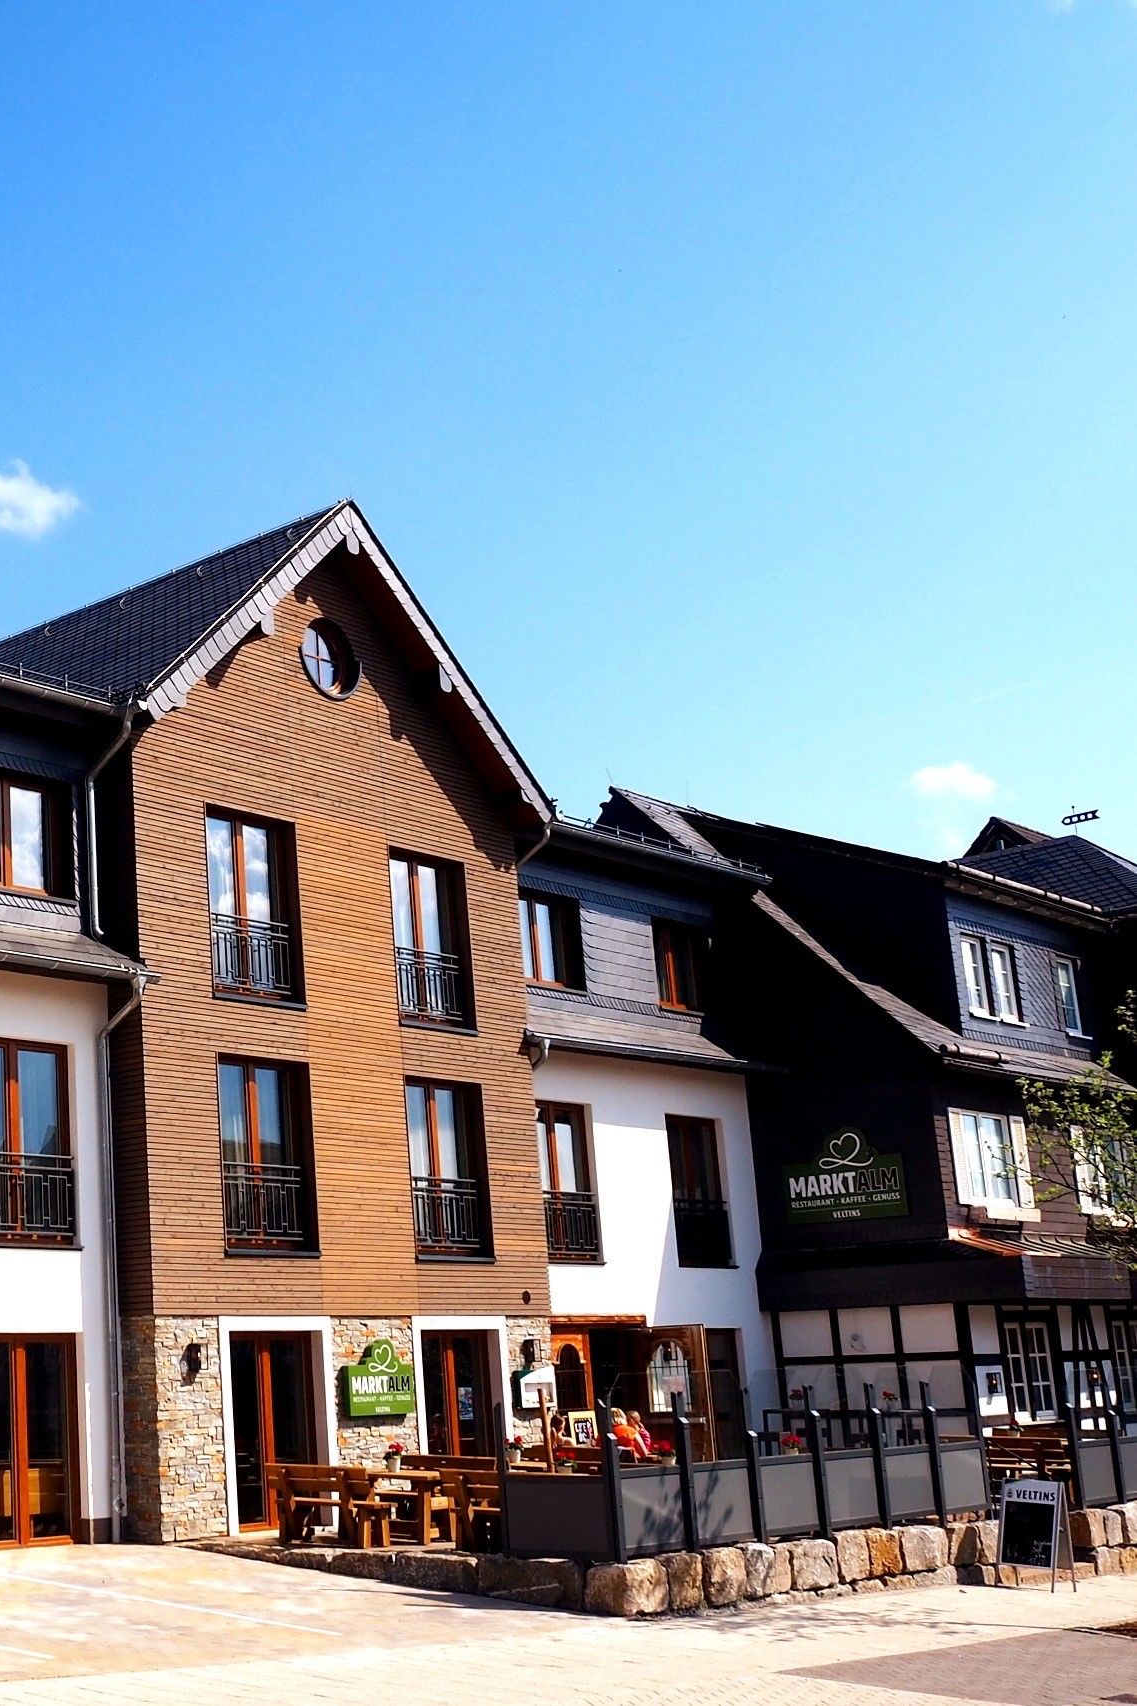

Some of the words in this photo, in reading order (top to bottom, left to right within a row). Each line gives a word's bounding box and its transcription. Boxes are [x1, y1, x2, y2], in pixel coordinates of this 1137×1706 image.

[788, 1166, 900, 1199] MARKTALM
[791, 1198, 834, 1208] RESTAURANT
[841, 1194, 866, 1204] KAFFEE
[872, 1192, 901, 1202] GENUSS
[832, 1209, 862, 1219] VELTINS
[351, 1375, 411, 1395] MARKTALM
[1015, 1489, 1055, 1501] VELTINS
